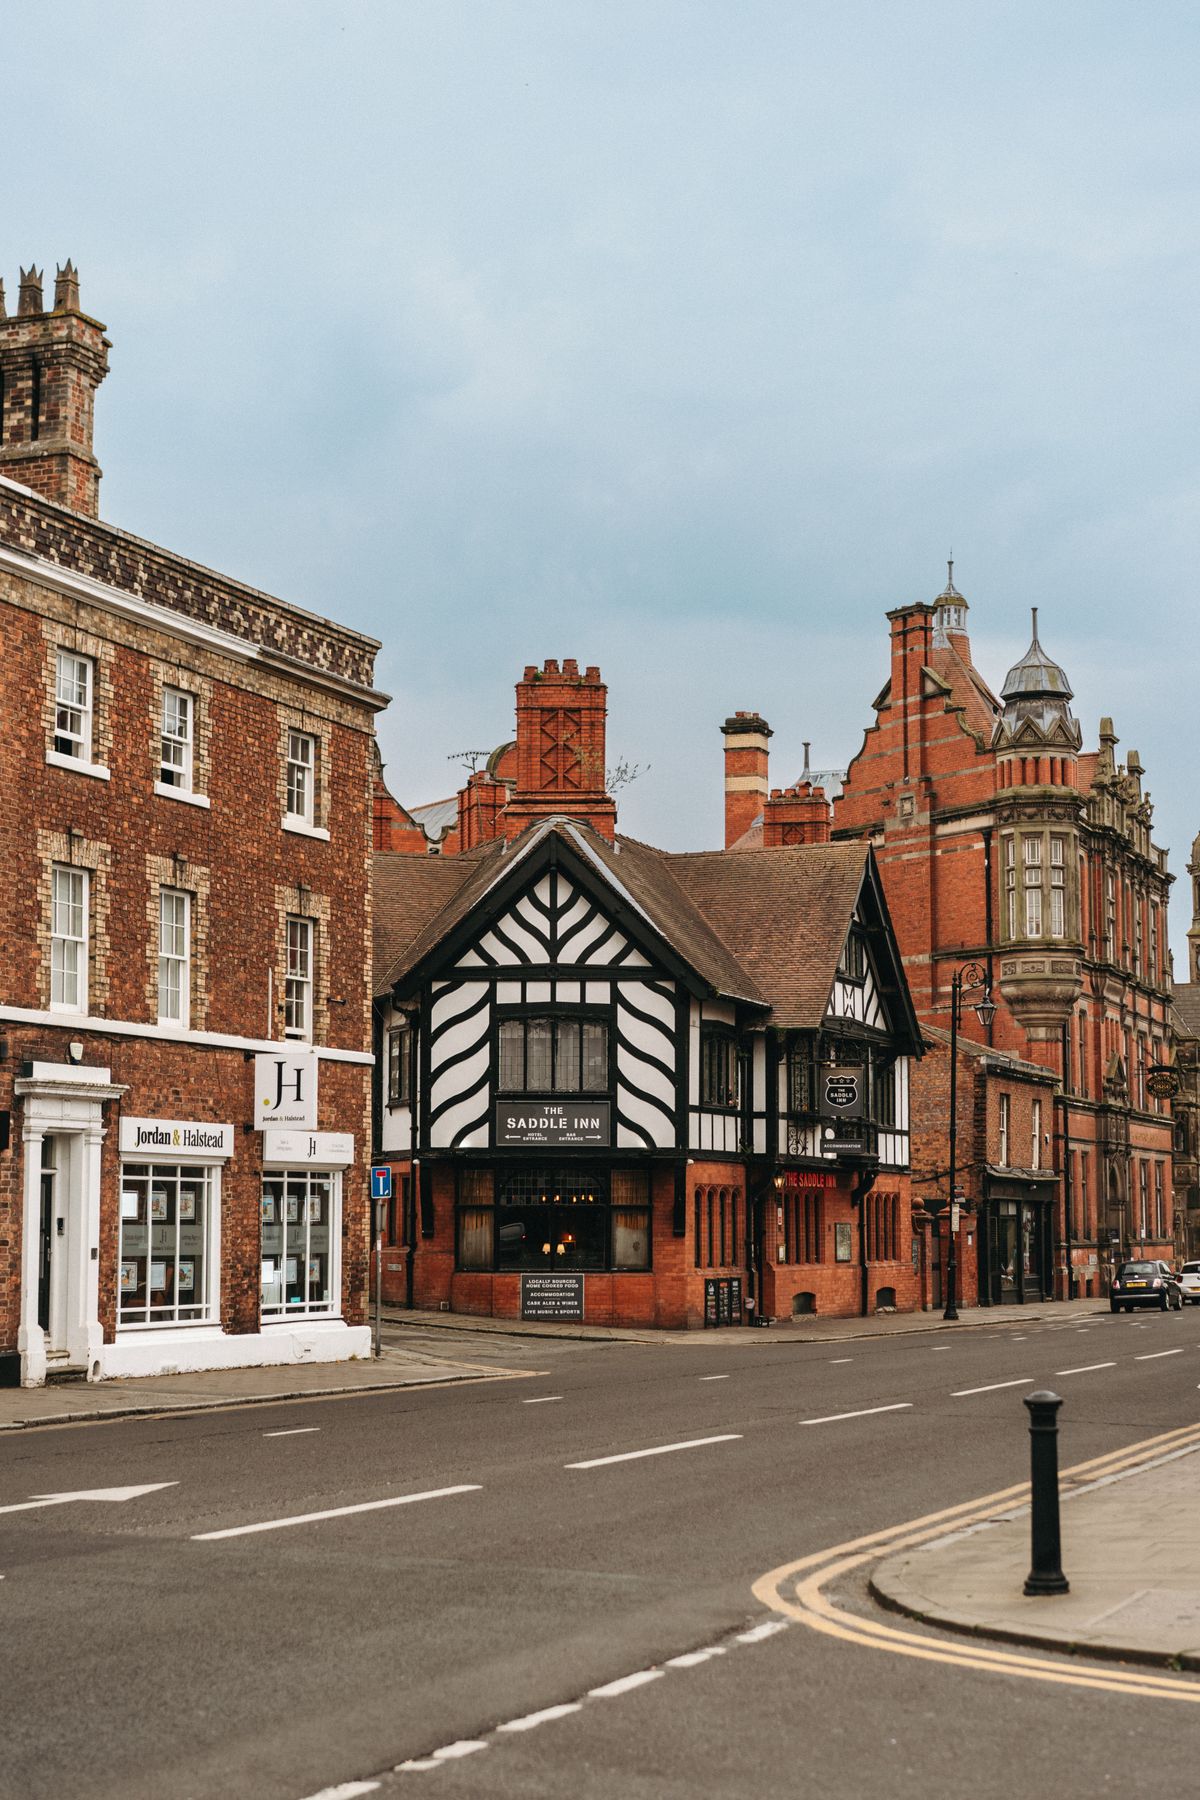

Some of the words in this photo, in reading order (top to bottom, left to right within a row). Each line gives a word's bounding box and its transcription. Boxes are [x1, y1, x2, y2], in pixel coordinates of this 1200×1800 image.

[506, 1117, 568, 1129] SADDLE
[574, 1118, 600, 1129] INN
[135, 1126, 171, 1148] Jordan
[172, 1129, 180, 1146] &
[183, 1129, 223, 1148] Halstead
[784, 1171, 798, 1187] THE
[799, 1172, 825, 1188] SADDLE
[825, 1174, 837, 1188] INN
